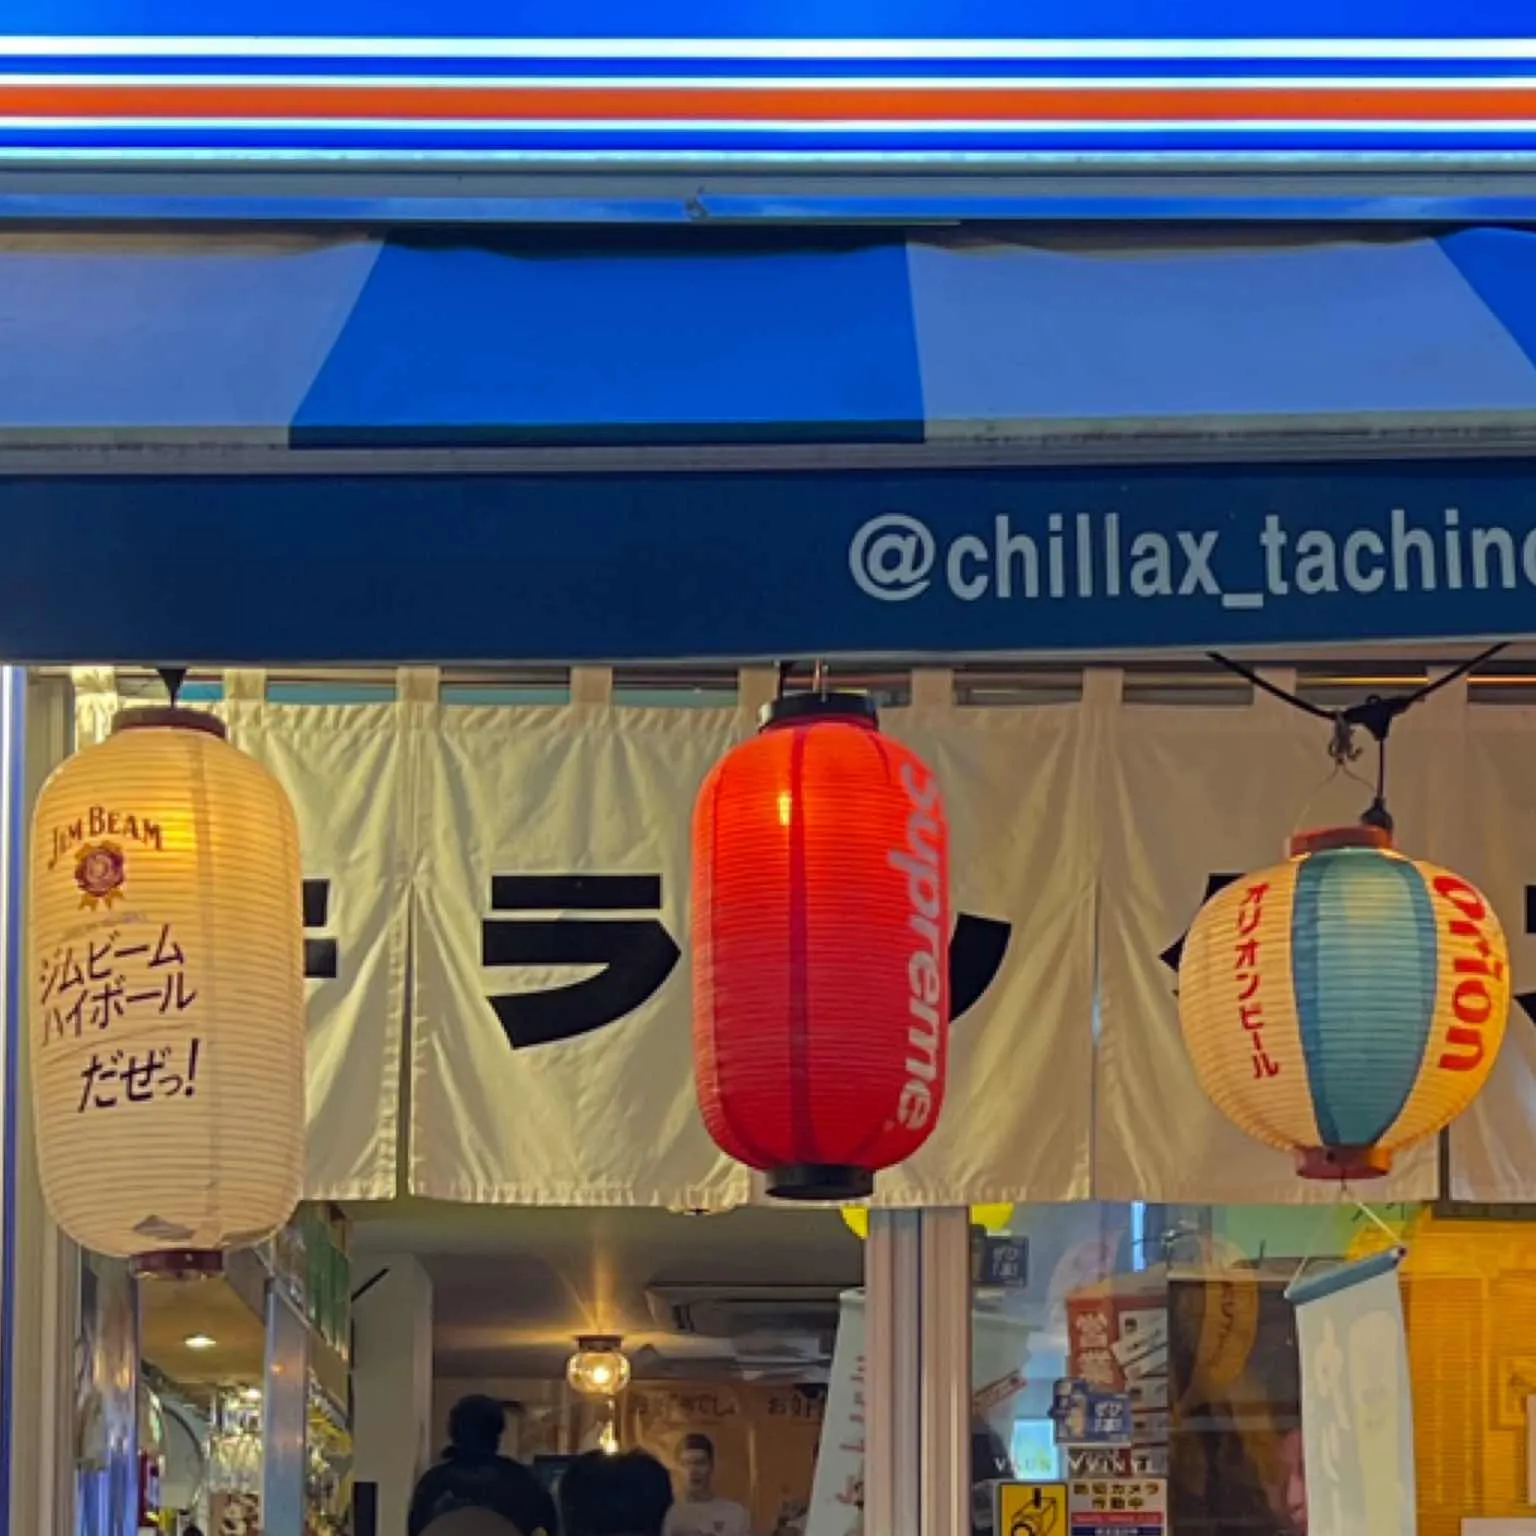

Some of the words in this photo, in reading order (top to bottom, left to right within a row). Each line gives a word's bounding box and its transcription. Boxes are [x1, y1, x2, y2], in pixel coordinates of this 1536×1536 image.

[47, 818, 82, 870] JIM
[89, 806, 163, 851] BEAM
[40, 923, 185, 1004] ジムビーム
[887, 762, 949, 1132] Supreme
[1432, 875, 1504, 1073] Orion
[41, 971, 197, 1046] ハイボール
